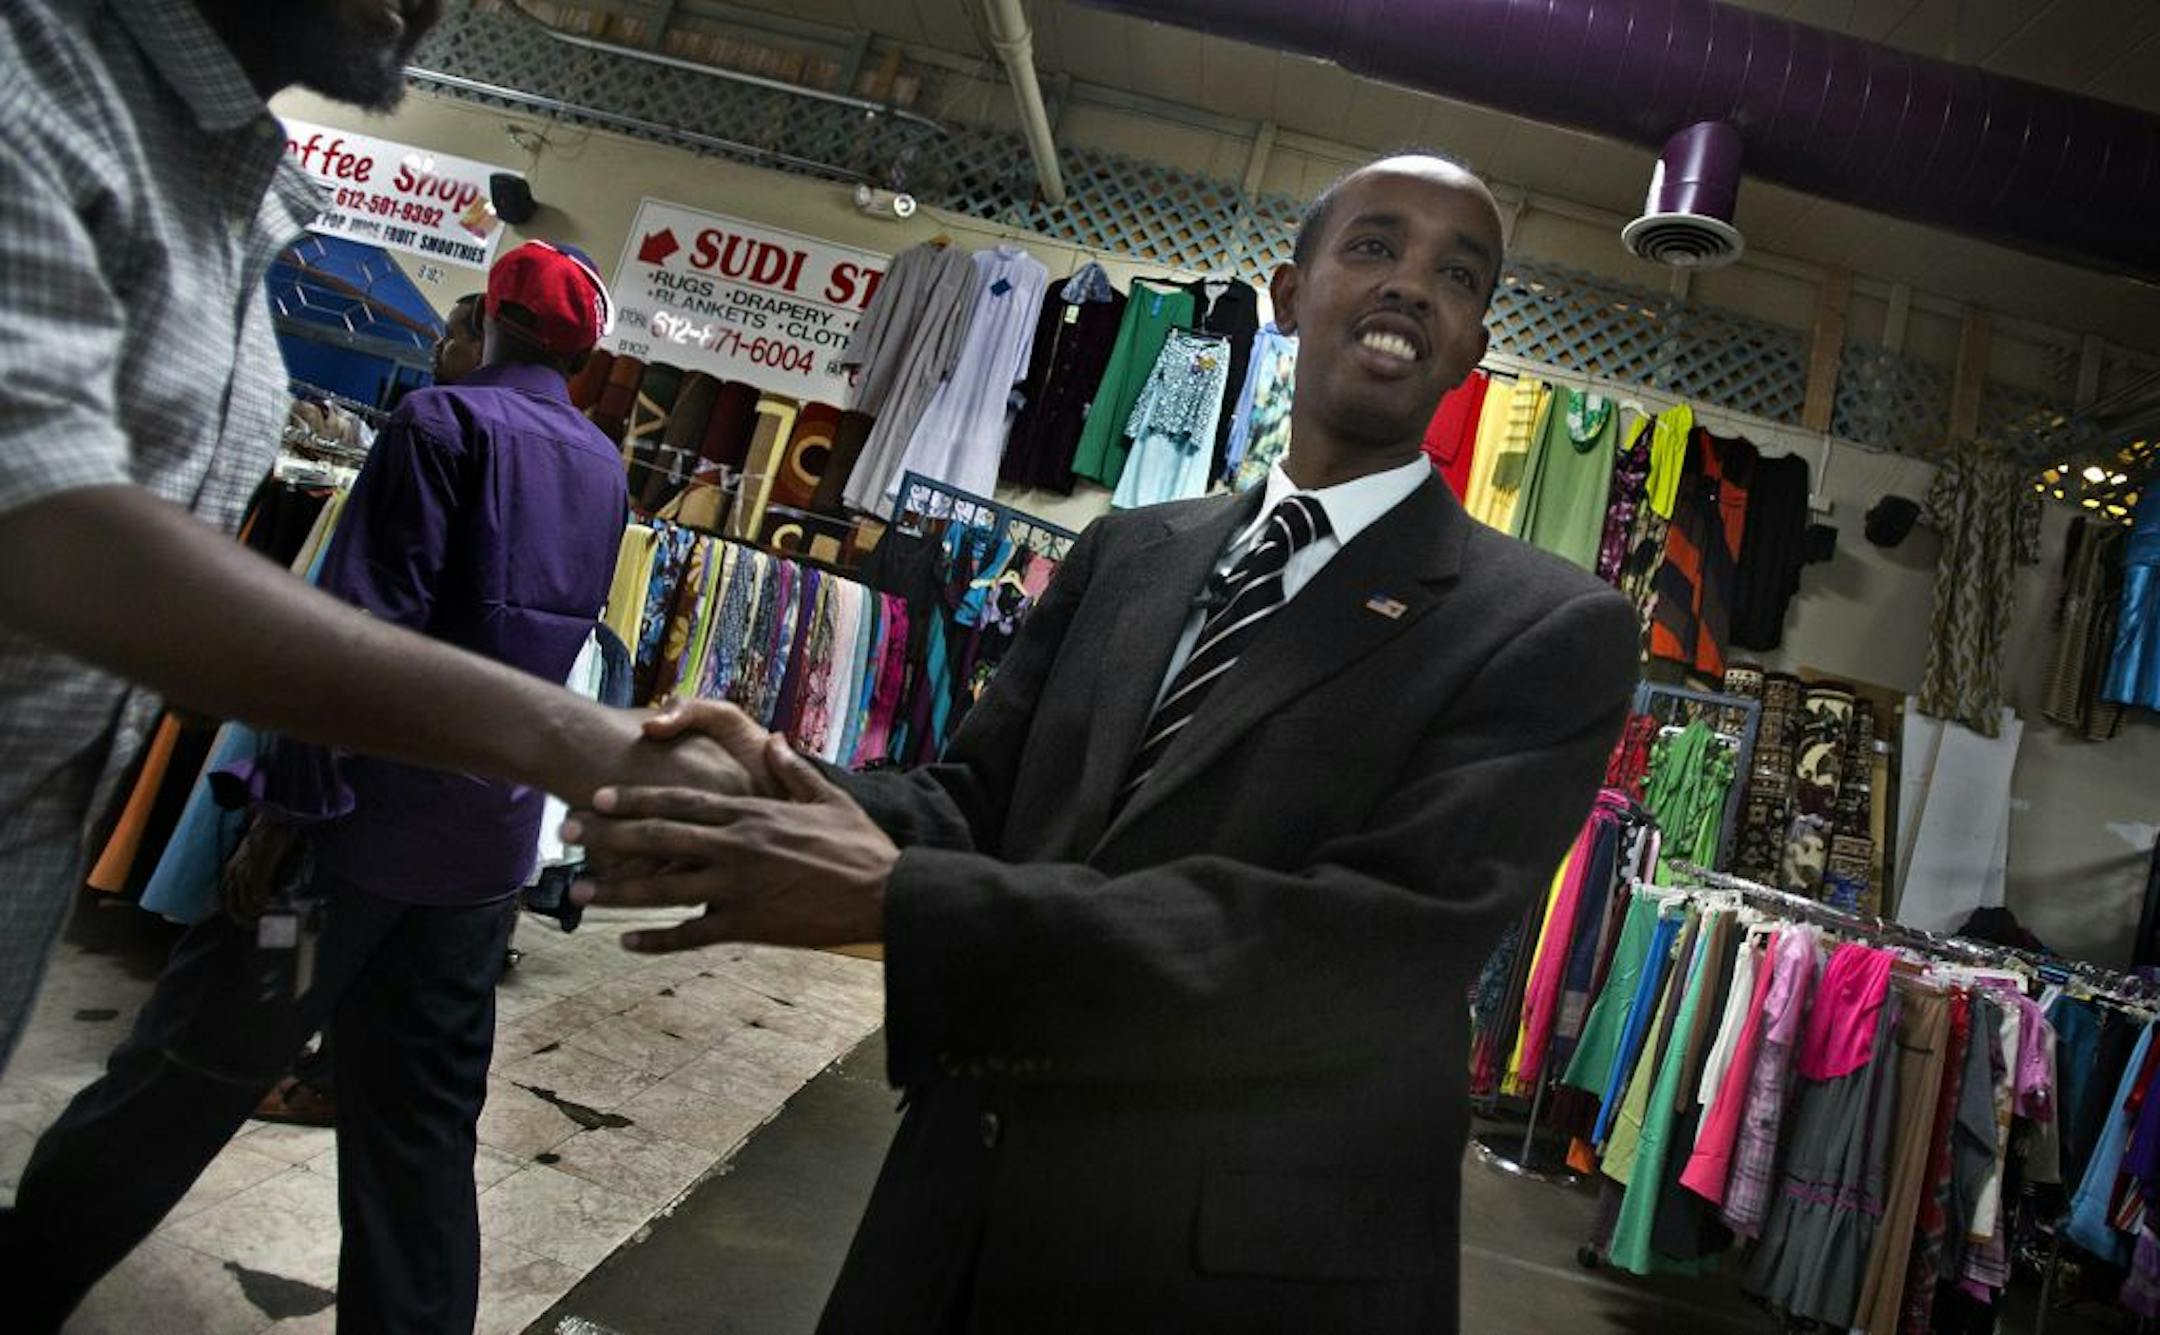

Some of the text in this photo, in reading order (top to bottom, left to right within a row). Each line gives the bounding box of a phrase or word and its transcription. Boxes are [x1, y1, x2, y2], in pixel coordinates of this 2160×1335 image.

[335, 187, 445, 229] 612-501-9392
[393, 154, 479, 213] Shop
[383, 225, 418, 247] FRUIT
[419, 234, 487, 264] SMOOTHIES
[688, 228, 808, 293] SUDI
[654, 270, 834, 327] RUGS DRAPERY
[655, 290, 767, 330] BLANKETS
